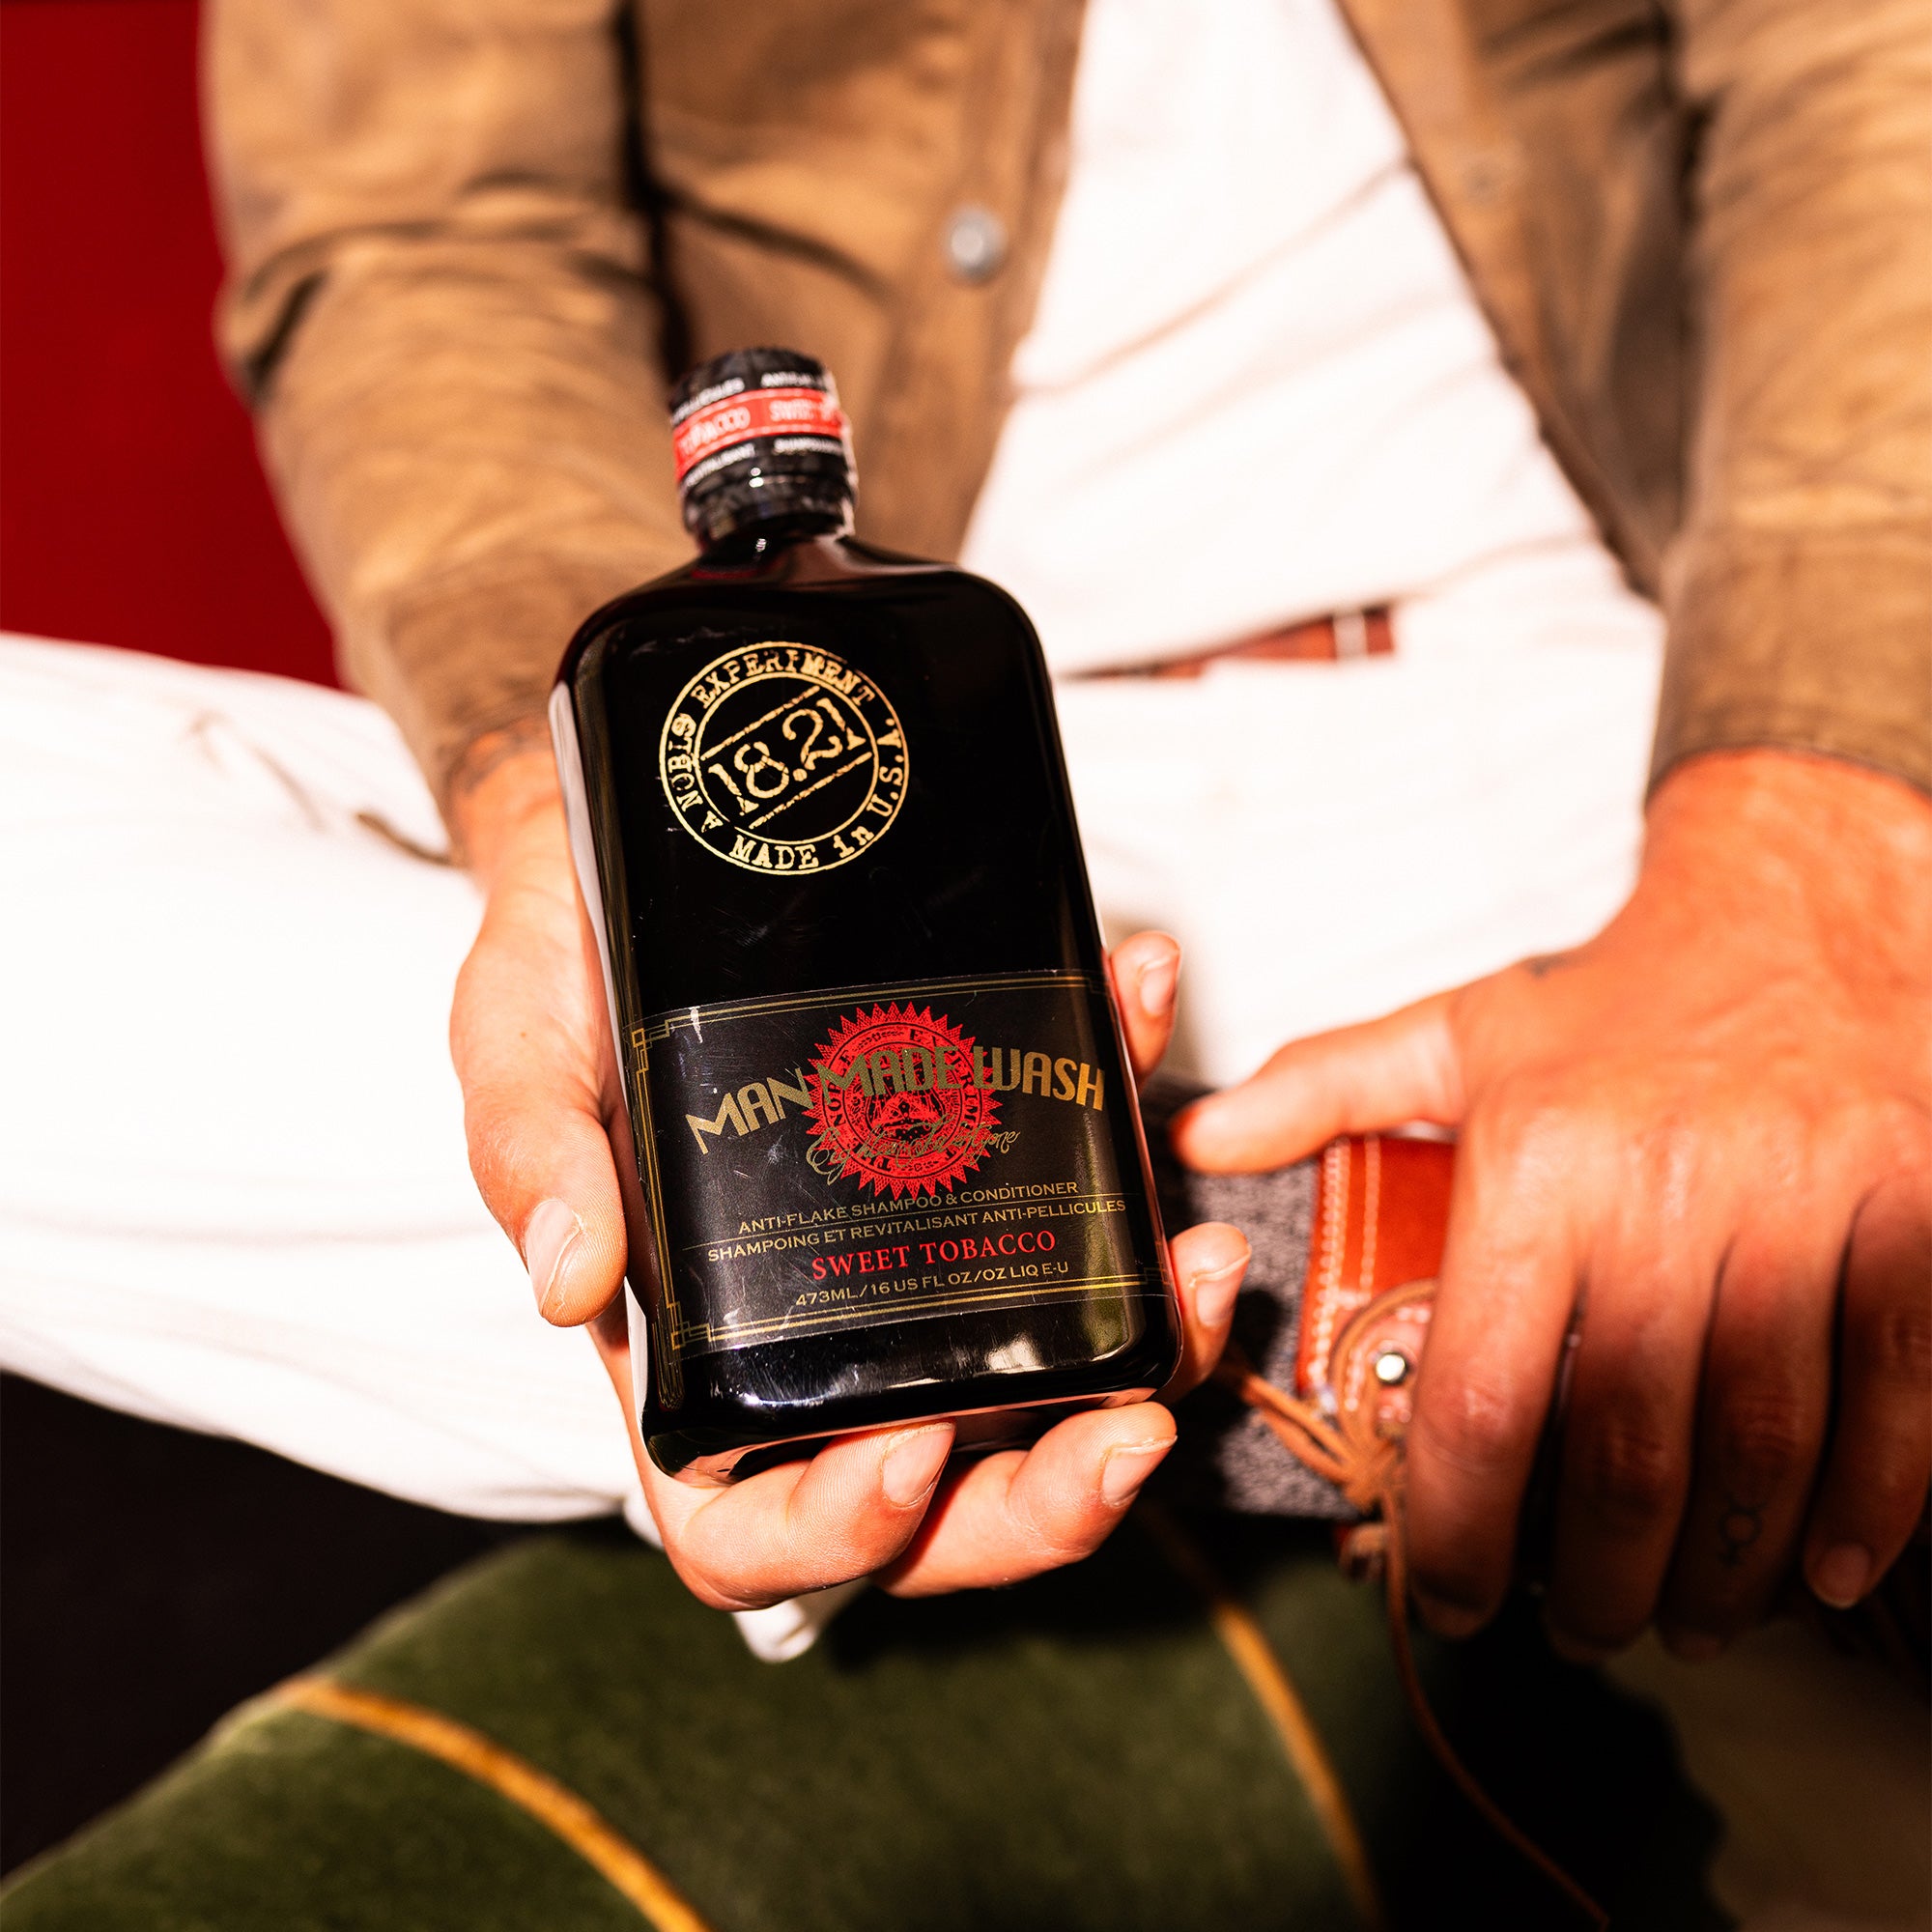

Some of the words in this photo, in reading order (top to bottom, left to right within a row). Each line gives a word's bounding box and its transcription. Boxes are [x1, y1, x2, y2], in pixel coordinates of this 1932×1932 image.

[690, 648, 876, 710] EXPERIMENT
[708, 697, 867, 816] 18.21
[701, 810, 724, 833] A
[729, 835, 819, 870] MADE
[833, 826, 875, 859] in
[685, 1067, 814, 1155] MAN
[816, 1045, 962, 1106] MADE
[973, 1045, 1106, 1112] WASH
[708, 1234, 820, 1262] SHAMPOING
[824, 1228, 846, 1244] ET
[850, 1212, 979, 1239] REVITALISANT
[981, 1200, 1126, 1224] ANTI-PELLICULES
[739, 1206, 847, 1235] ANTI-FLAKE
[851, 1194, 942, 1217] SHAMPOO
[946, 1193, 958, 1206] &
[959, 1181, 1079, 1204] CONDITIONER
[811, 1245, 911, 1281] SWEET
[920, 1230, 1056, 1264] TOBACCO
[894, 1276, 918, 1292] US
[922, 1274, 946, 1289] FL
[1010, 1264, 1039, 1279] LIQ
[1042, 1261, 1069, 1275] E-U
